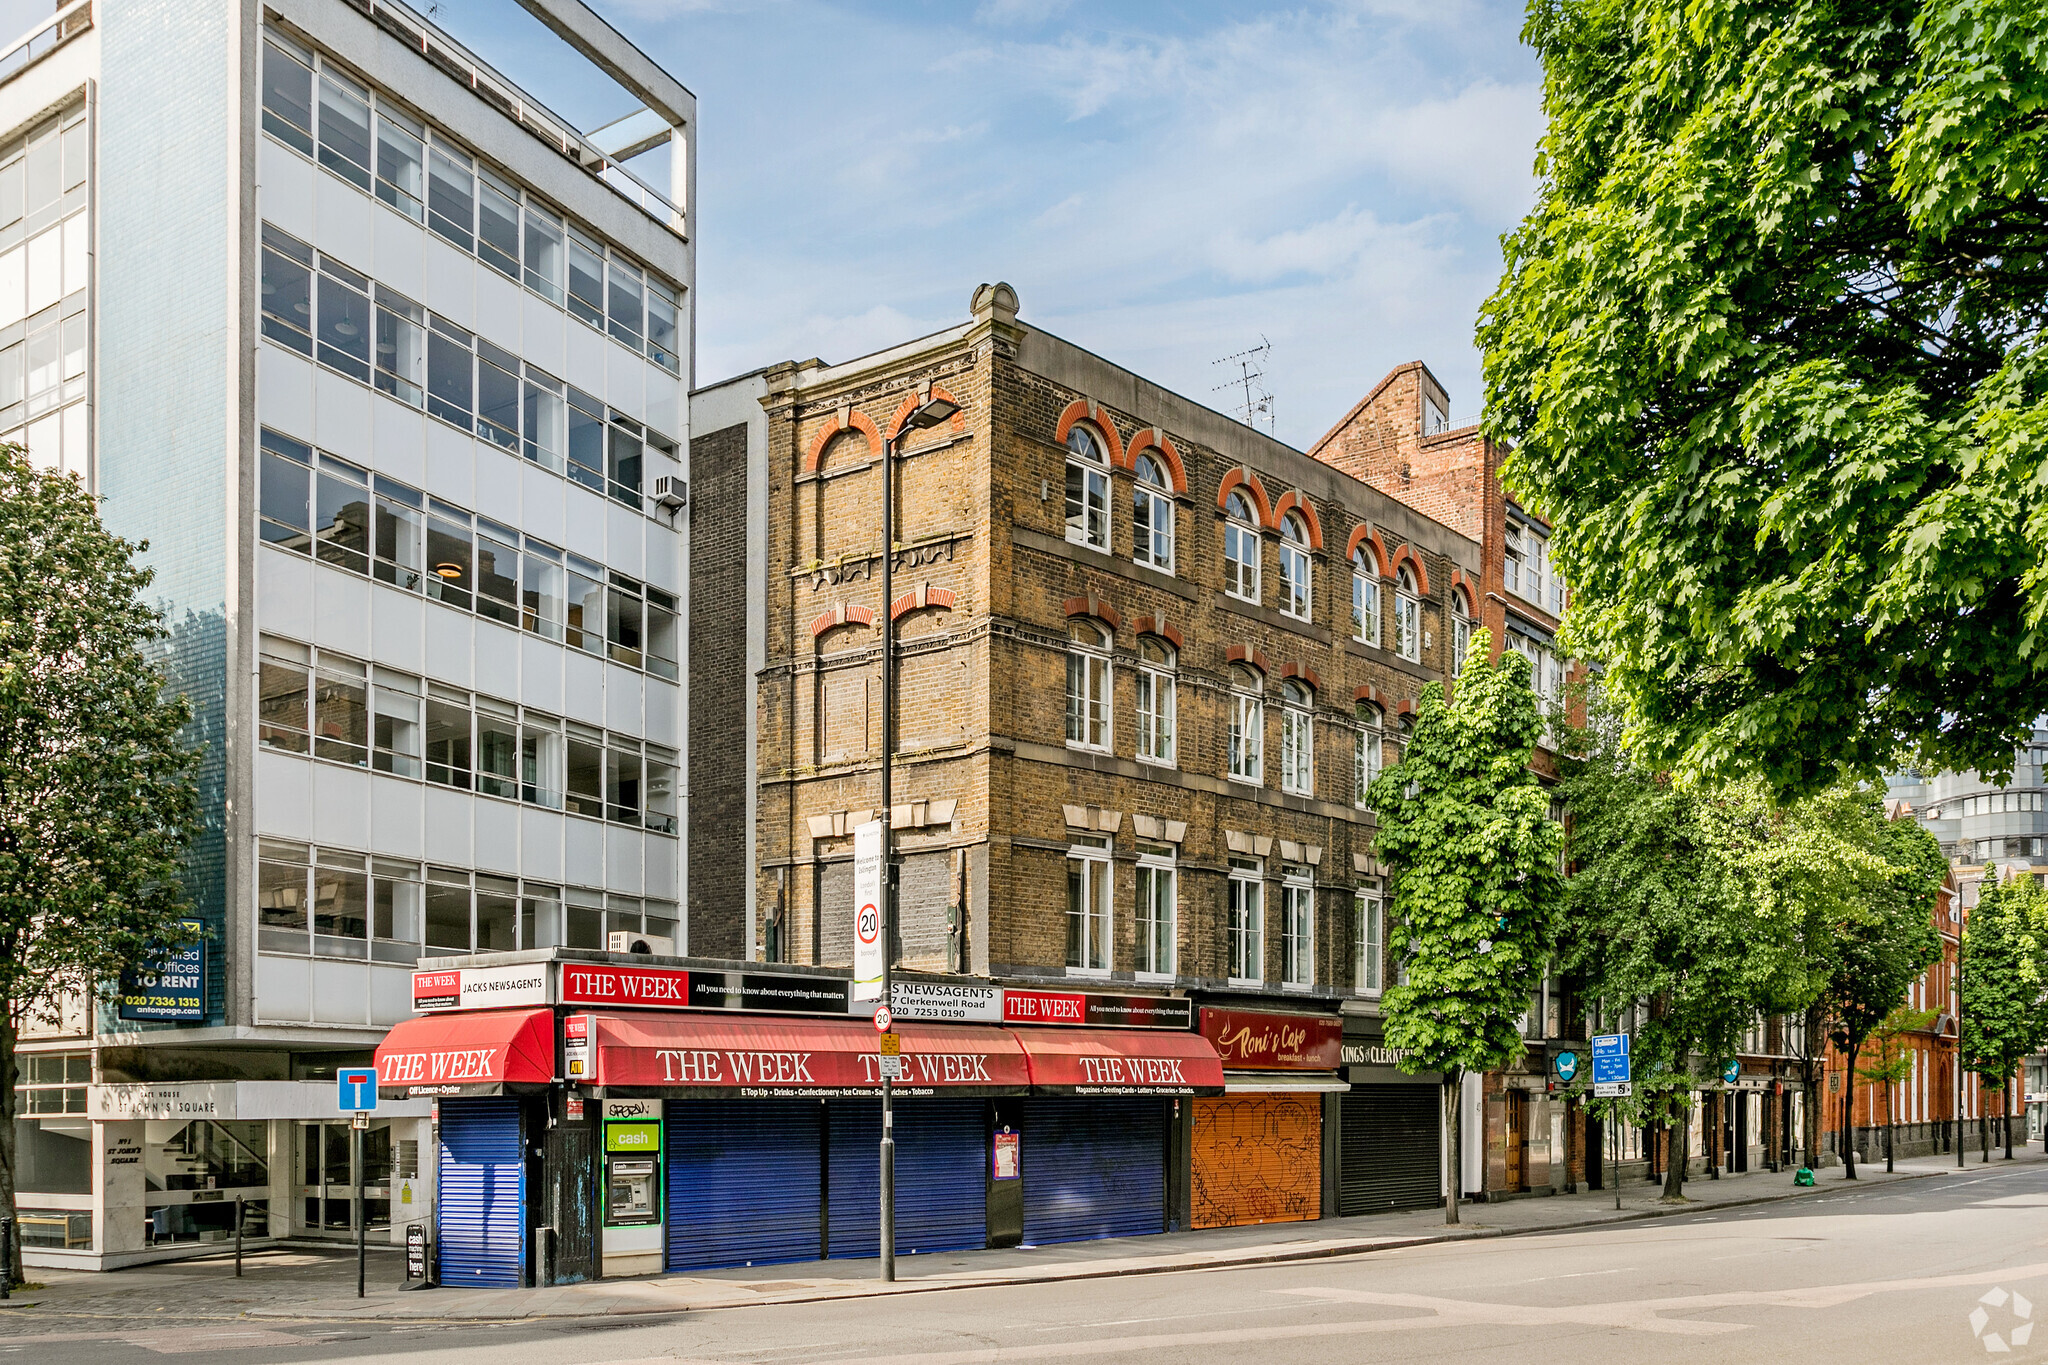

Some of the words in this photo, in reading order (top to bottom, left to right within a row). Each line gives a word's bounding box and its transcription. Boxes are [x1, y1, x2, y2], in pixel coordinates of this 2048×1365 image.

[861, 914, 876, 933] 20
[156, 961, 200, 974] Offices
[161, 975, 200, 989] RENT
[417, 977, 432, 988] THE
[434, 975, 456, 987] WEEK
[463, 983, 487, 994] JACKS
[488, 978, 542, 992] NEWSAGENTS
[570, 973, 616, 996] THE
[619, 975, 682, 999] WEEK
[696, 984, 706, 992] All
[706, 986, 718, 994] you
[719, 986, 734, 994] need
[735, 986, 742, 994] to
[742, 987, 759, 995] know
[760, 988, 777, 996] about
[778, 988, 809, 999] everything
[810, 990, 822, 998] that
[822, 991, 845, 1000] matters
[904, 984, 994, 999] NEWSAGENTS
[125, 995, 147, 1005] 020
[149, 996, 176, 1006] 7336
[178, 997, 200, 1007] 1313
[900, 997, 958, 1007] Clerkenwell
[961, 1000, 985, 1008] Road
[1007, 997, 1037, 1016] THE
[1039, 998, 1080, 1018] WEEK
[137, 1006, 200, 1016] antonpage.com
[891, 1007, 909, 1015] 020
[914, 1008, 938, 1016] 7253
[941, 1009, 965, 1018] 0190
[1121, 1006, 1132, 1014] know
[1144, 1007, 1166, 1016] everything
[877, 1014, 888, 1024] 20
[1240, 1026, 1279, 1058] Roni's
[1278, 1052, 1303, 1062] breakfast
[1306, 1053, 1320, 1062] lunch
[1340, 1045, 1364, 1063] KINGS
[382, 1053, 427, 1081] THE
[430, 1049, 497, 1080] WEEK
[655, 1050, 723, 1082] THE
[725, 1051, 815, 1083] WEEK
[857, 1054, 914, 1082] TE
[915, 1054, 992, 1083] WEEK
[1079, 1058, 1125, 1083] THE
[1125, 1058, 1186, 1084] WEEK
[408, 1086, 418, 1095] Off
[418, 1086, 438, 1095] Licence
[441, 1085, 461, 1095] Oyster
[741, 1088, 746, 1096] E
[746, 1088, 758, 1097] Top
[759, 1088, 768, 1097] Up
[774, 1088, 794, 1096] Drinks
[798, 1088, 839, 1097] Confectionery
[843, 1088, 851, 1096] Ice
[852, 1088, 871, 1096] Cream
[911, 1088, 933, 1096] Tobacco
[1076, 1086, 1100, 1095] Magazines
[1103, 1086, 1121, 1095] Greeting
[1137, 1087, 1153, 1095] Lottery
[179, 1102, 215, 1113] SQUARE
[618, 1131, 648, 1144] cash
[409, 1233, 423, 1245] cash
[409, 1259, 423, 1272] here
